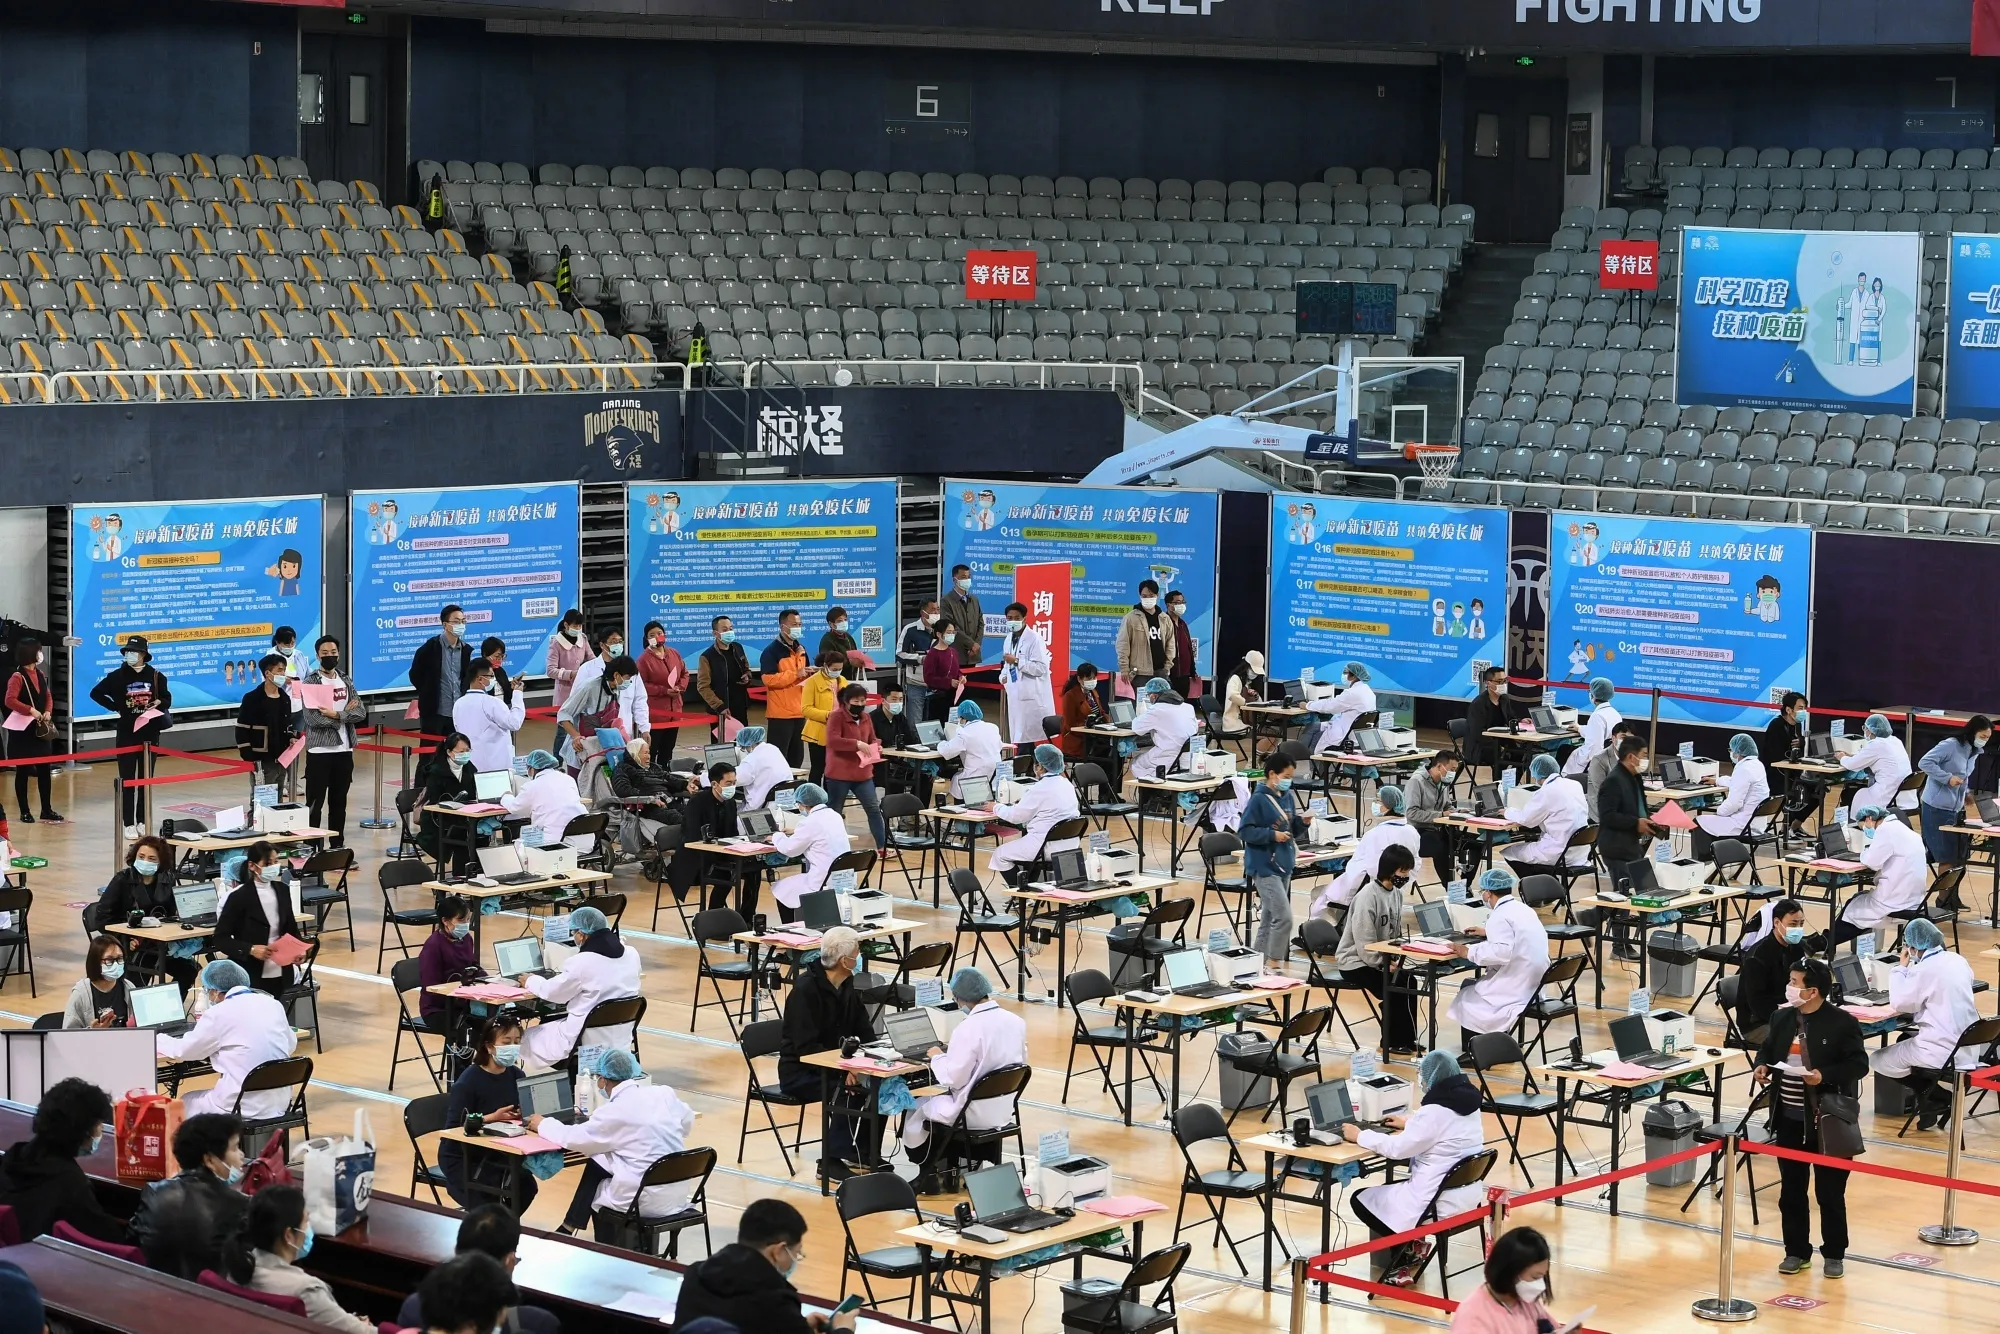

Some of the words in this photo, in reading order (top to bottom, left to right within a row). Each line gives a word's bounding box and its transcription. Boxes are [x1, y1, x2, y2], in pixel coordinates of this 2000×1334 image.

[916, 85, 939, 116] 6
[1604, 254, 1653, 275] 等待区
[971, 264, 1030, 285] 等待区
[1695, 277, 1788, 308] 科学防控
[1712, 309, 1806, 342] 接种疫苗
[602, 399, 641, 410] NANJING
[693, 501, 779, 520] 接种新冠疫苗
[787, 497, 870, 516] 共筑免疫长城
[1008, 504, 1094, 521] 接种新冠疫苗
[1101, 506, 1190, 524] 共筑免疫长城
[408, 507, 481, 529] 接种新冠疫苗
[486, 502, 558, 524] 共筑免疫长城
[133, 522, 216, 544] 接种新冠疫苗
[221, 516, 299, 539] 共筑免疫长城
[675, 529, 694, 541] Q11
[1000, 526, 1020, 537] Q13
[1325, 518, 1400, 537] 接种新冠疫苗
[1406, 522, 1484, 542] 共筑免疫长城
[397, 540, 410, 551] Q8
[1314, 542, 1331, 554] Q16
[1610, 538, 1692, 558] 接种新冠疫苗
[1699, 542, 1785, 562] 共筑免疫长城
[121, 556, 136, 568] Q6
[970, 561, 990, 572] Q14
[1597, 564, 1617, 576] Q19
[393, 582, 406, 593] Q9
[1296, 578, 1313, 590] Q17
[650, 593, 671, 604] Q12
[1574, 603, 1593, 614] Q20
[376, 618, 394, 629] Q10
[1289, 615, 1306, 627] Q18
[98, 634, 113, 646] Q7
[1618, 641, 1637, 654] Q21
